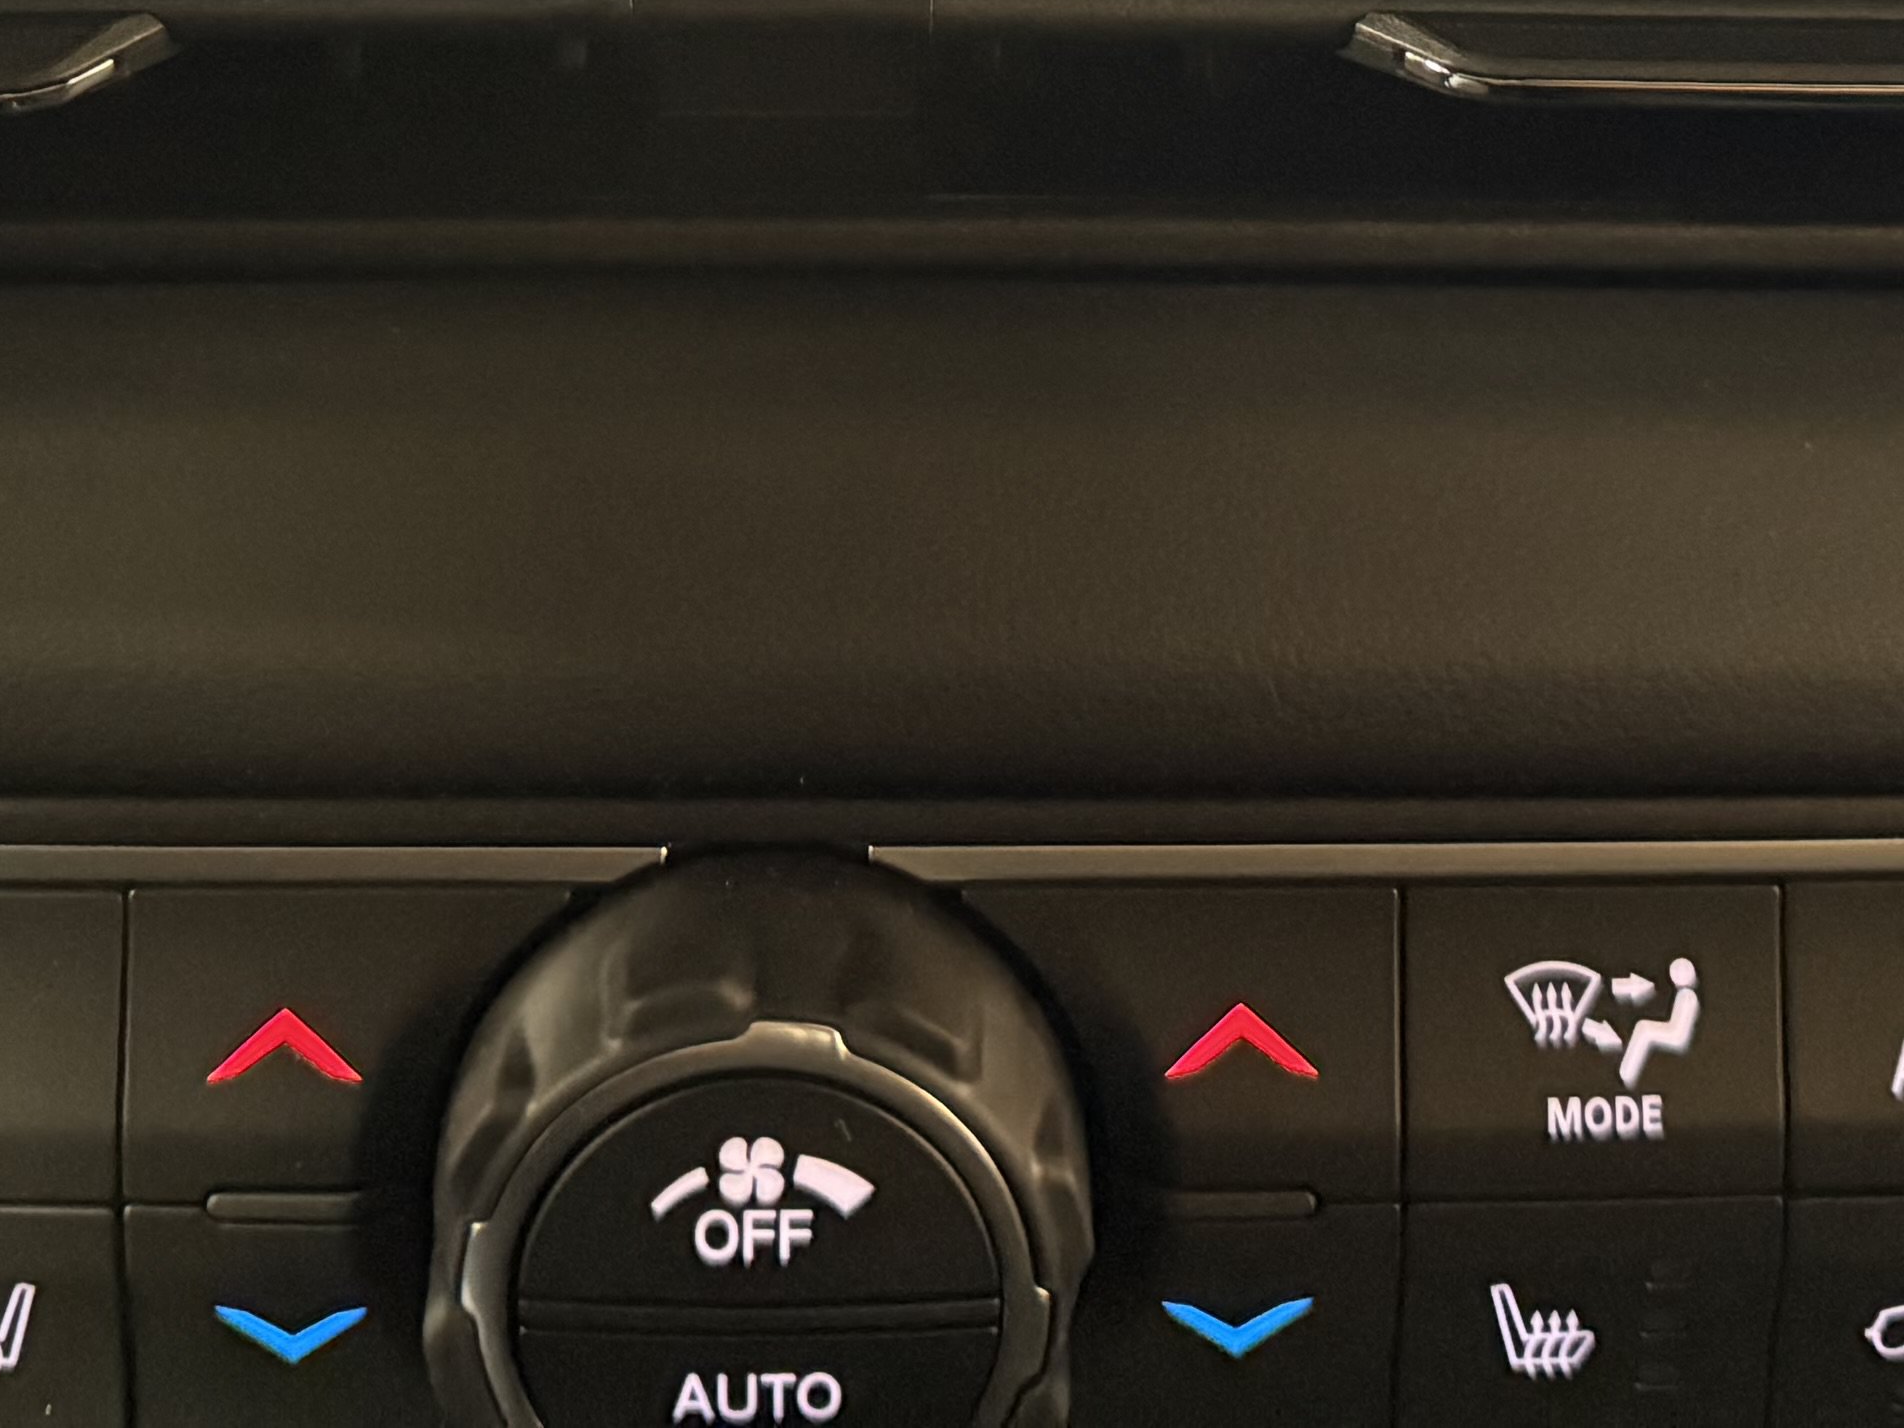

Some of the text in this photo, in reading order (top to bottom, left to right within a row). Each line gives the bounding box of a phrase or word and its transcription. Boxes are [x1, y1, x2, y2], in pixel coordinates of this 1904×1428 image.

[1546, 1093, 1665, 1140] MODE
[694, 1208, 814, 1270] OFF
[671, 1369, 844, 1425] AUTO
